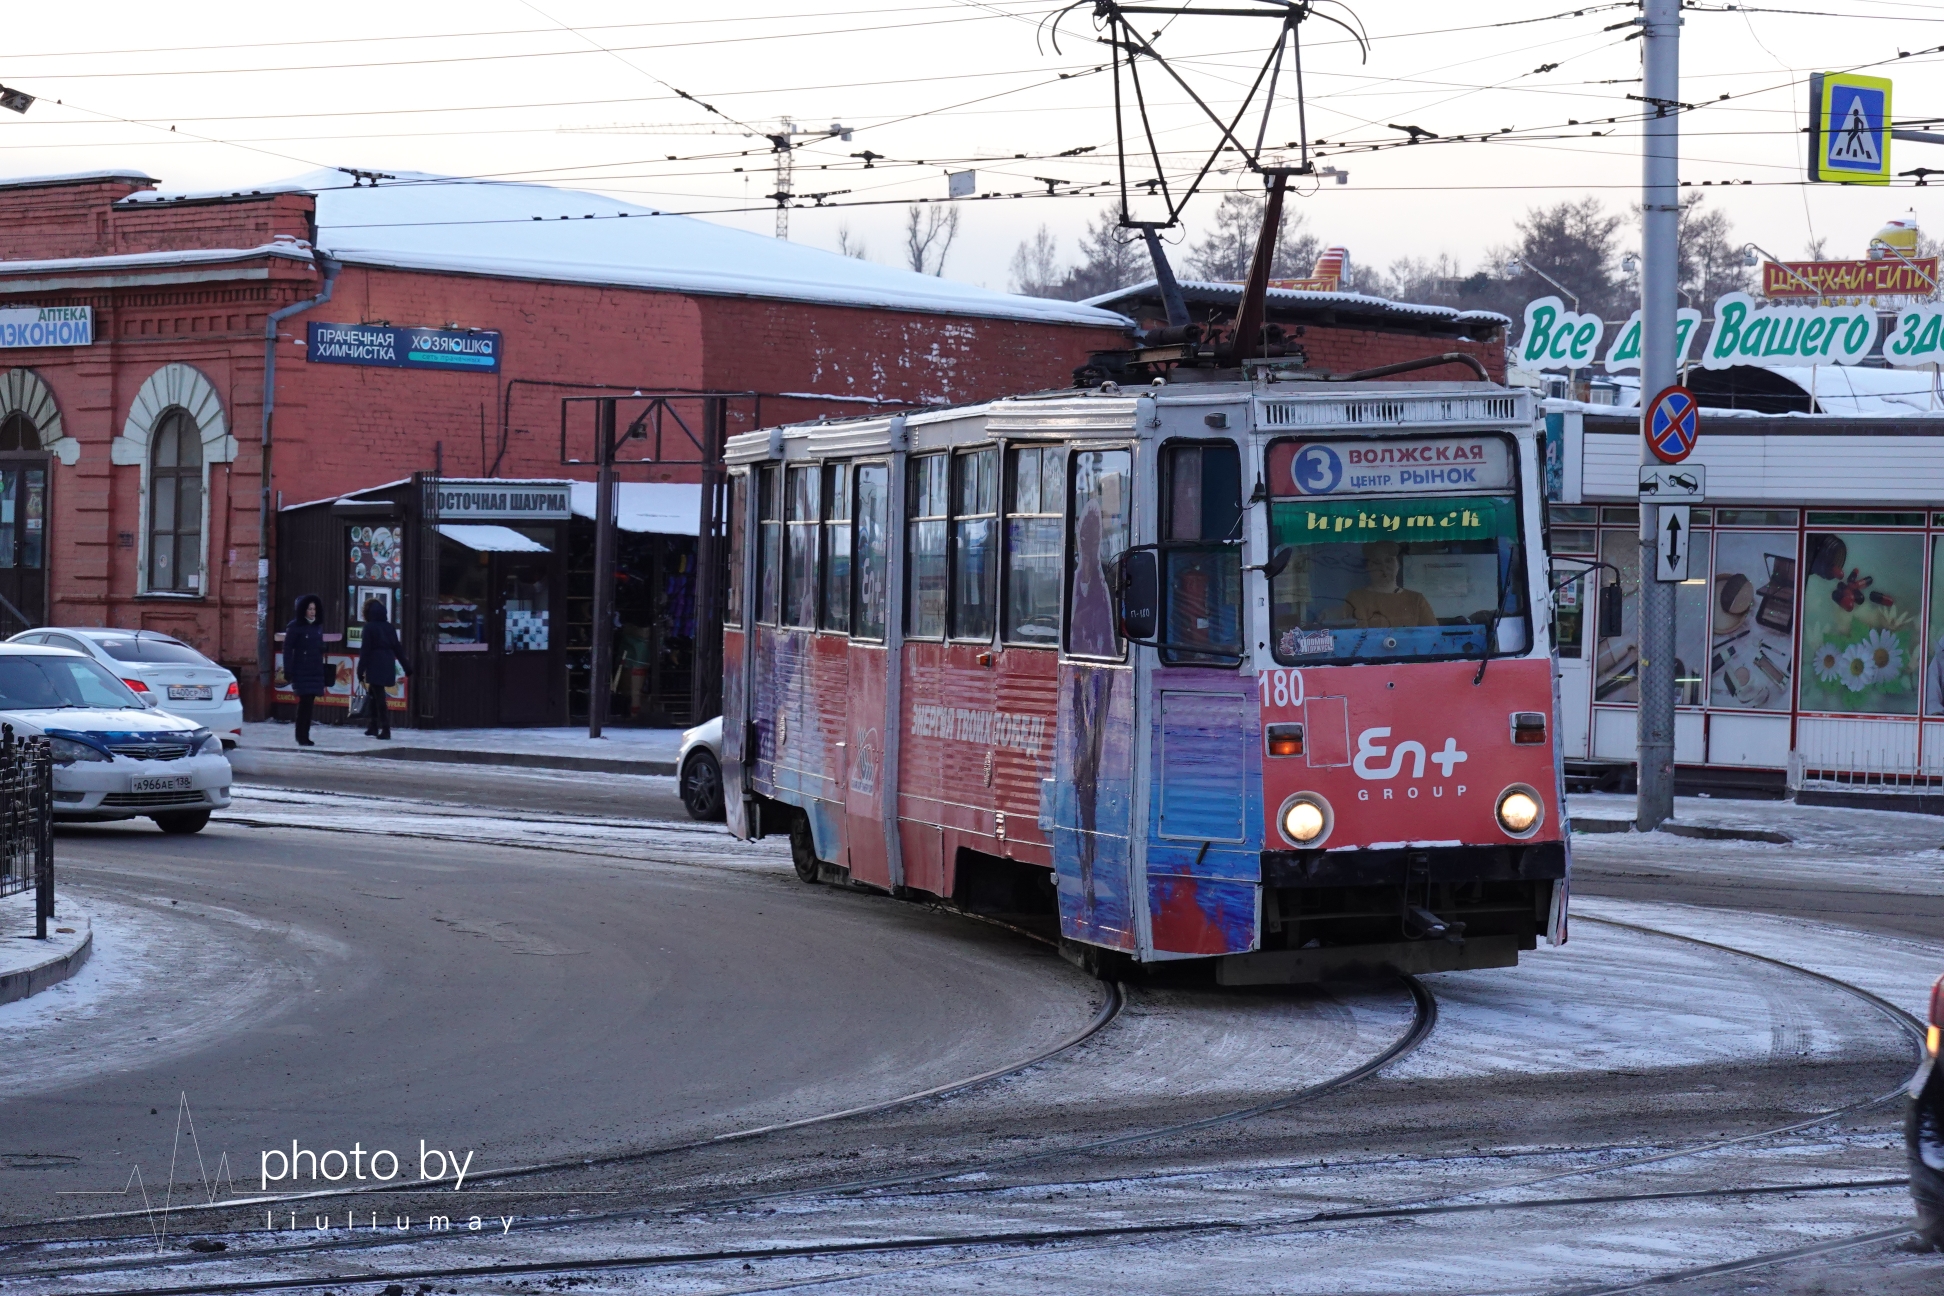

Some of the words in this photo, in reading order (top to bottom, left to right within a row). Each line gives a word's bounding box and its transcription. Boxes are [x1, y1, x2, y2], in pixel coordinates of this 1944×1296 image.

[38, 307, 88, 322] АПТЕКА
[317, 328, 395, 346] ПРАЧЕЧНАЯ
[1525, 306, 1596, 361] Все
[1613, 319, 1694, 362] дя
[1713, 301, 1870, 359] Вашего
[1892, 313, 1944, 356] зд
[317, 343, 396, 361] ХИМЧИСТКА
[1349, 445, 1484, 464] ВОЛЖСКАЯ
[1306, 450, 1333, 490] 3
[1350, 474, 1393, 488] ЦЕНТР.
[1400, 467, 1477, 485] РЫНОК
[510, 493, 567, 511] ШАУРМА
[1306, 508, 1482, 532] Иркутск
[1259, 669, 1304, 707] 180
[956, 708, 993, 744] ТВОИХ
[1353, 726, 1468, 780] En+
[136, 778, 174, 791] А966АЕ
[1357, 785, 1467, 801] GROUP
